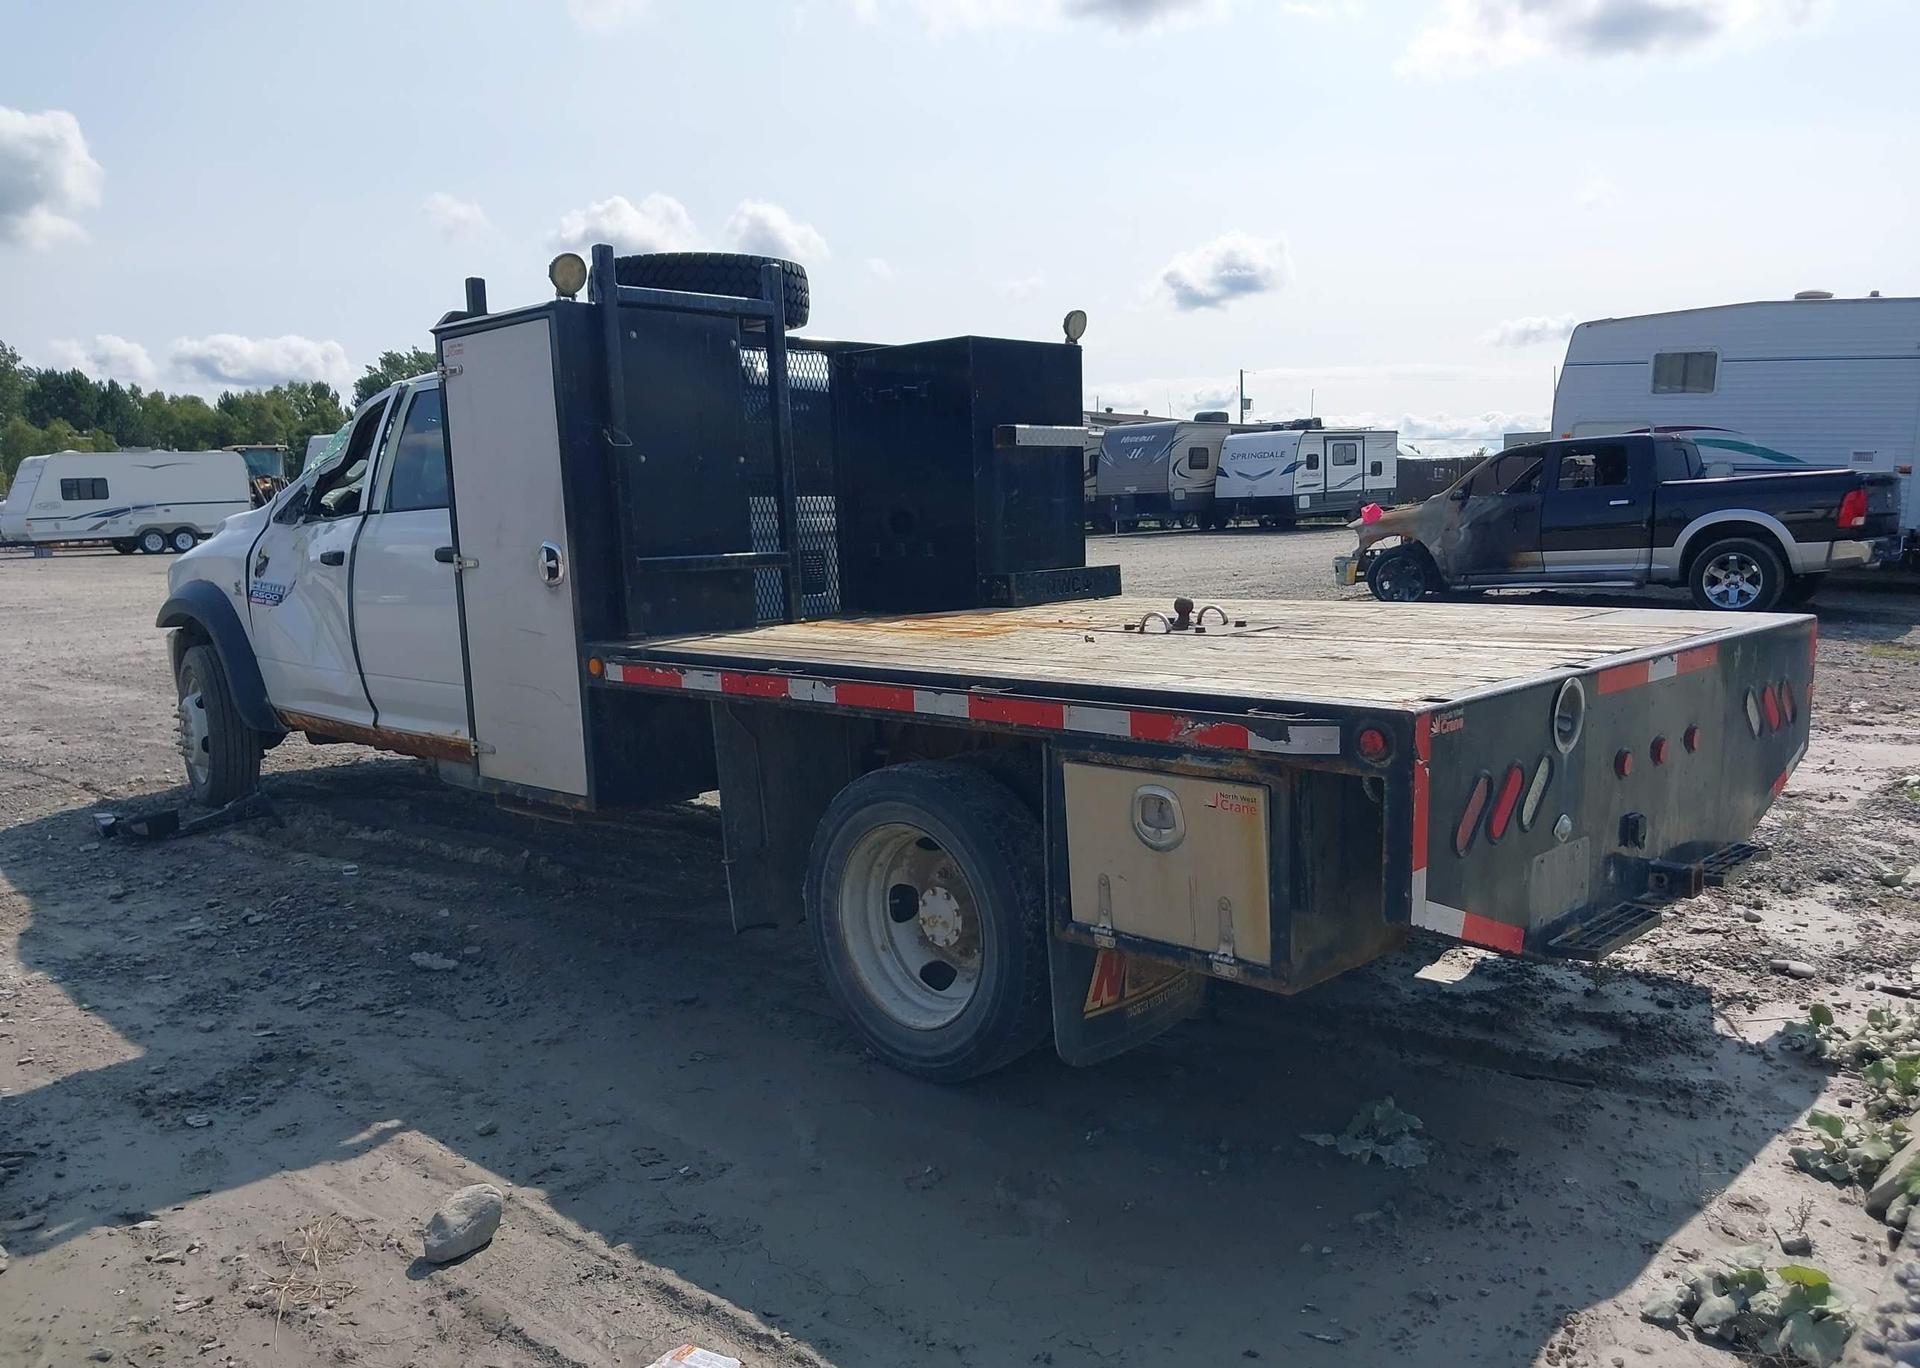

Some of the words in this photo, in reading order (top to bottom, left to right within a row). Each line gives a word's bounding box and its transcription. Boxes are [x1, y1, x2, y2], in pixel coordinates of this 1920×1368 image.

[1230, 450, 1287, 461] SPRINGDALE
[1219, 791, 1239, 801] North
[1239, 794, 1257, 804] West
[1220, 799, 1257, 816] Crane
